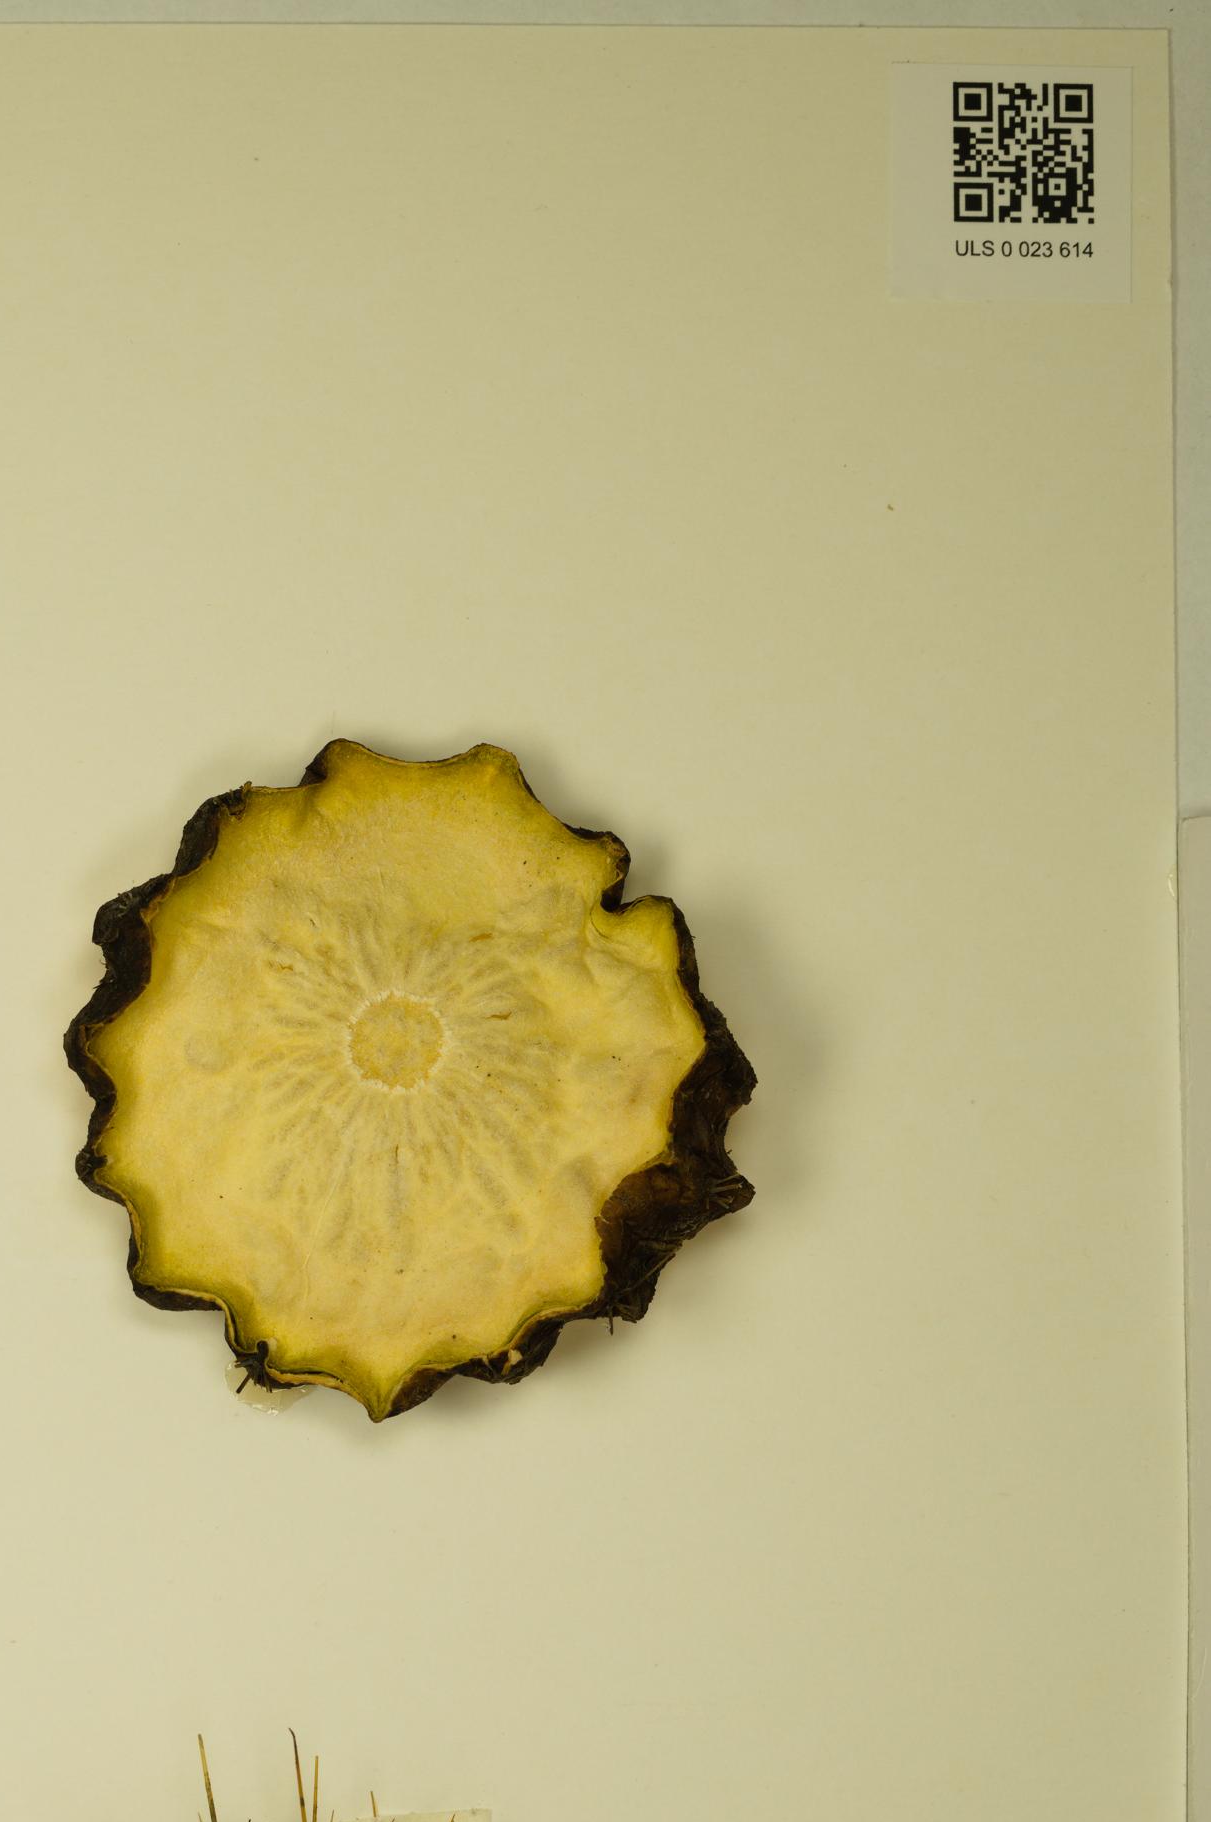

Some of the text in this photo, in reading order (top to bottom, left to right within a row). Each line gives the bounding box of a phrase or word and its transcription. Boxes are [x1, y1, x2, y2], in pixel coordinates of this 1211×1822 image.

[955, 239, 1094, 258] ULS 0 023 614
